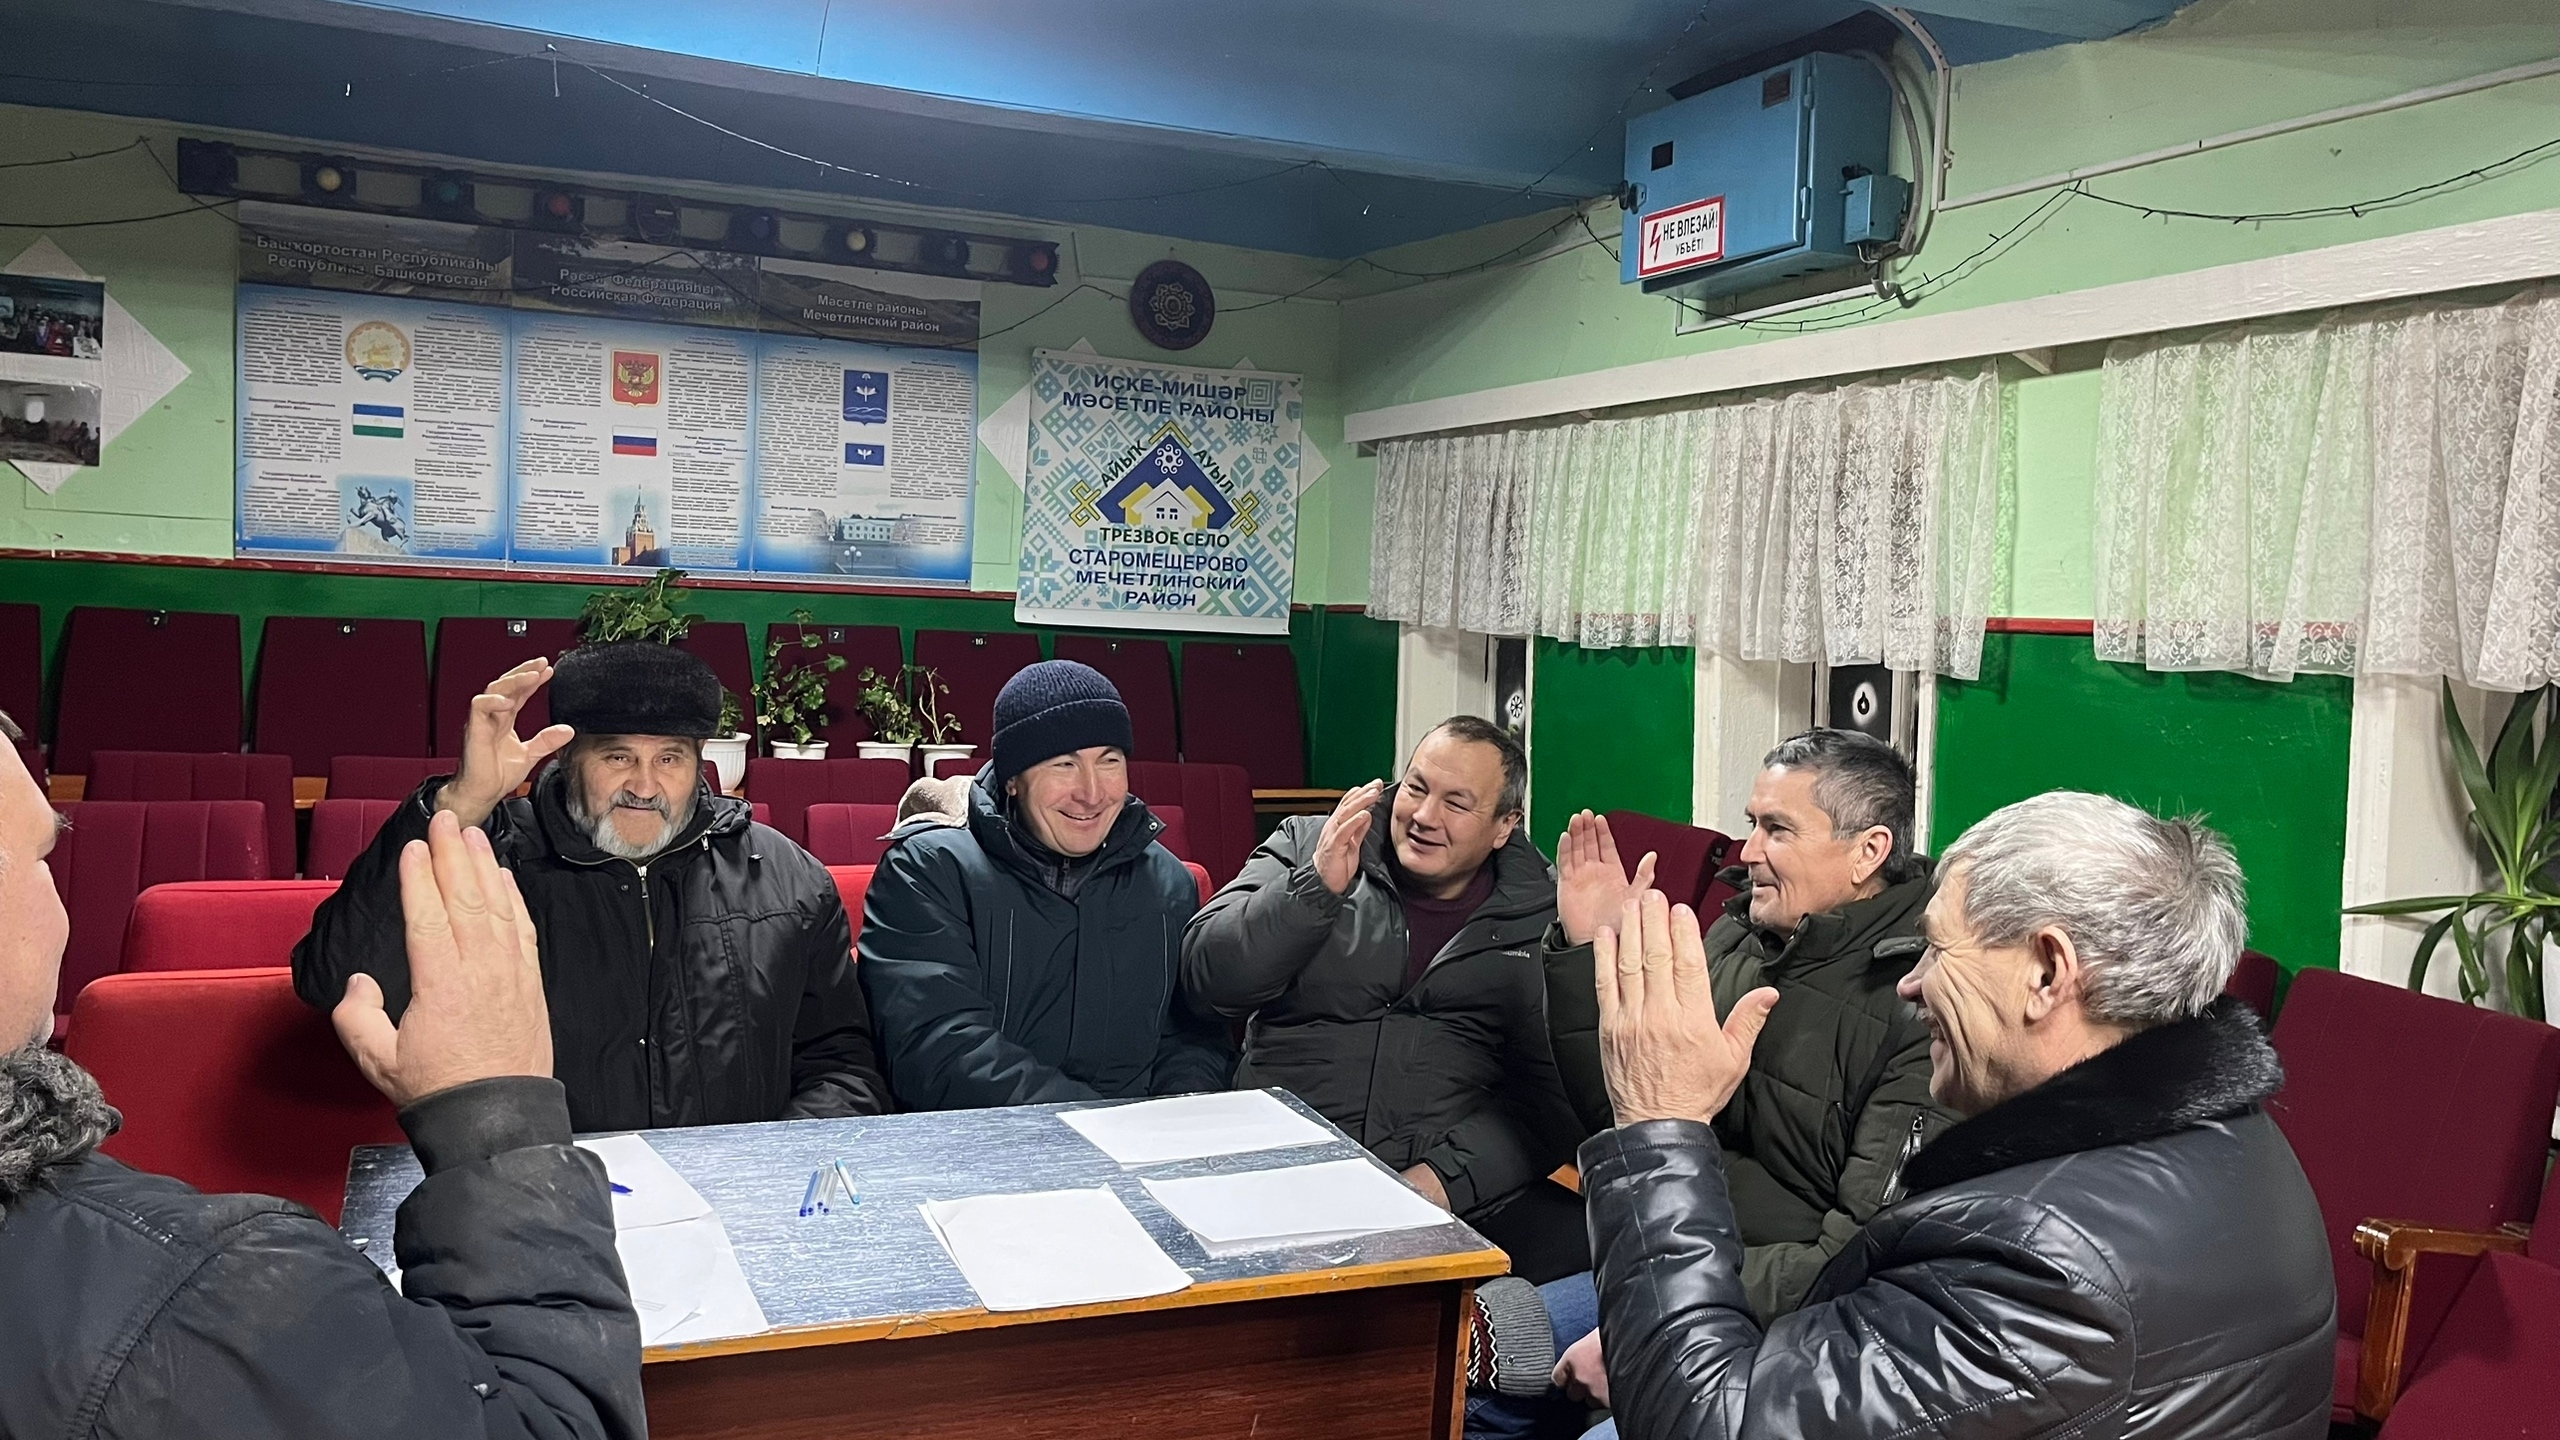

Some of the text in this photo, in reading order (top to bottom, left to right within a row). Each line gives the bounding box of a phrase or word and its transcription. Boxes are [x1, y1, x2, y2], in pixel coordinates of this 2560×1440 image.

[1663, 208, 1718, 241] НЕ ВЛЕЗАЙ!
[257, 235, 499, 273] Башҡортостан Республикаһы
[1675, 237, 1704, 256] УБЪЁТ!
[267, 254, 488, 287] Республика Башкортостан
[612, 274, 714, 295] Федерацияһы
[551, 285, 721, 311] Российская Федерация
[817, 294, 927, 316] Мәсетле районы
[803, 308, 940, 332] Мечетлинский район
[1062, 391, 1275, 424] МӘСЕТЛЕ РАЙОНЫ
[1193, 449, 1235, 494] АУЫЛ
[1099, 527, 1230, 548] ТРЕЗВОЕ СЕЛО
[1068, 548, 1248, 573] СТАРОМЕЩЕРОВО
[1076, 570, 1246, 591] МЕЧЕТЛИНСКИЙ
[1125, 588, 1196, 607] РАЙОН
